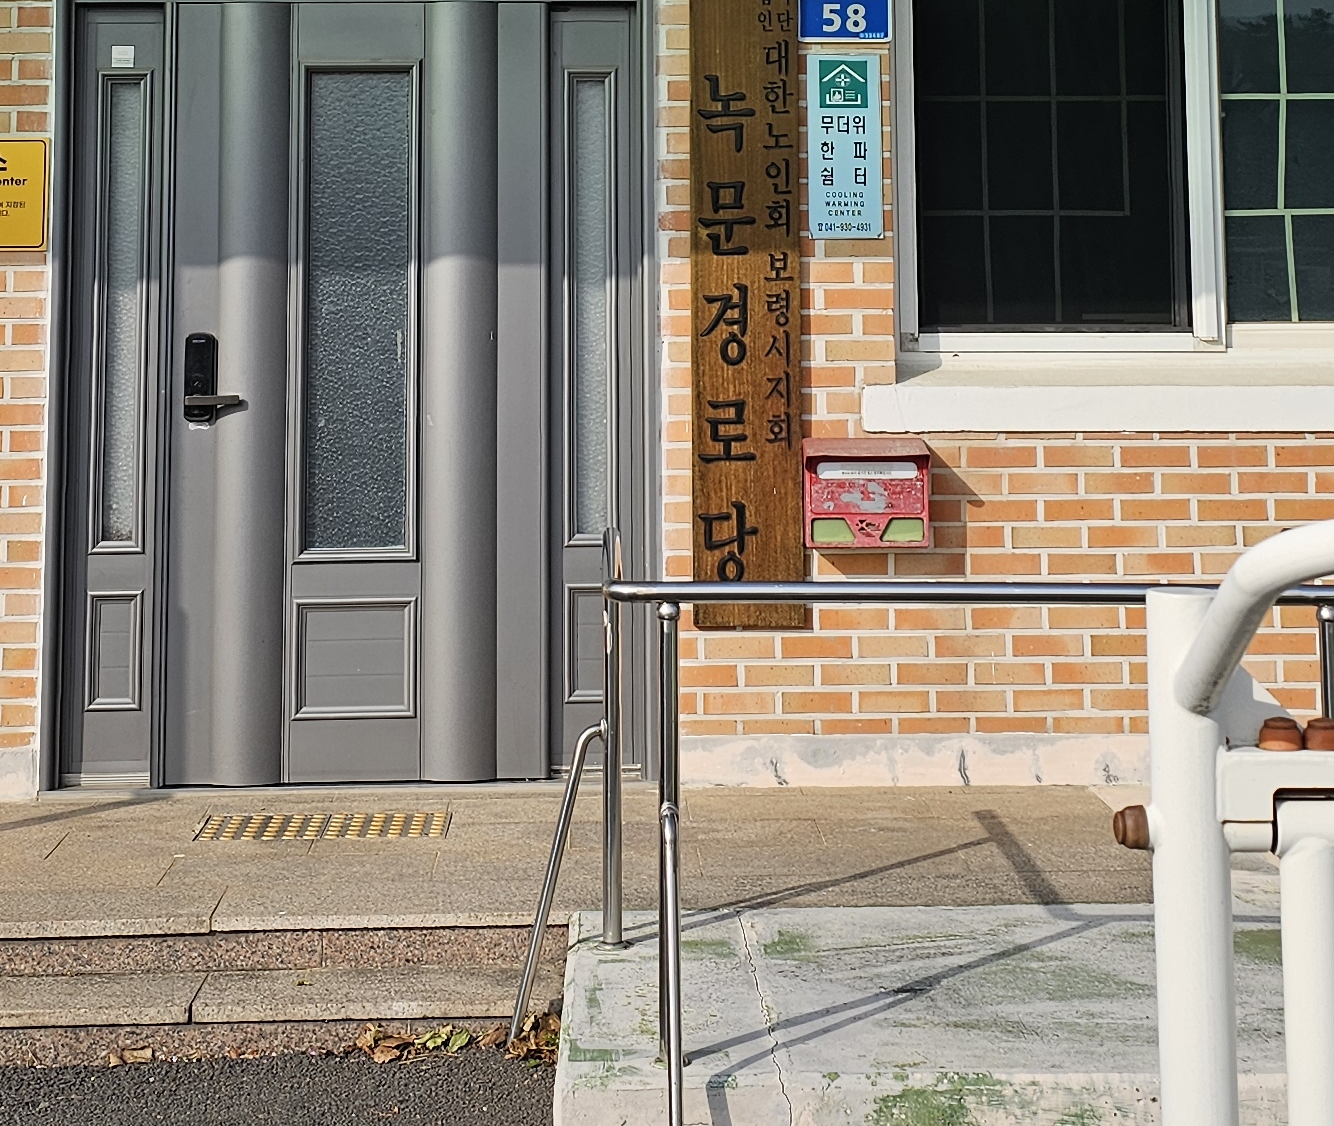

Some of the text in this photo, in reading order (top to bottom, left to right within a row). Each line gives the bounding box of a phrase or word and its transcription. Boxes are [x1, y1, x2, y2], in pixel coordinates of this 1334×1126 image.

[822, 3, 867, 33] 58
[820, 115, 866, 135] 무더위
[825, 191, 864, 199] COOLING
